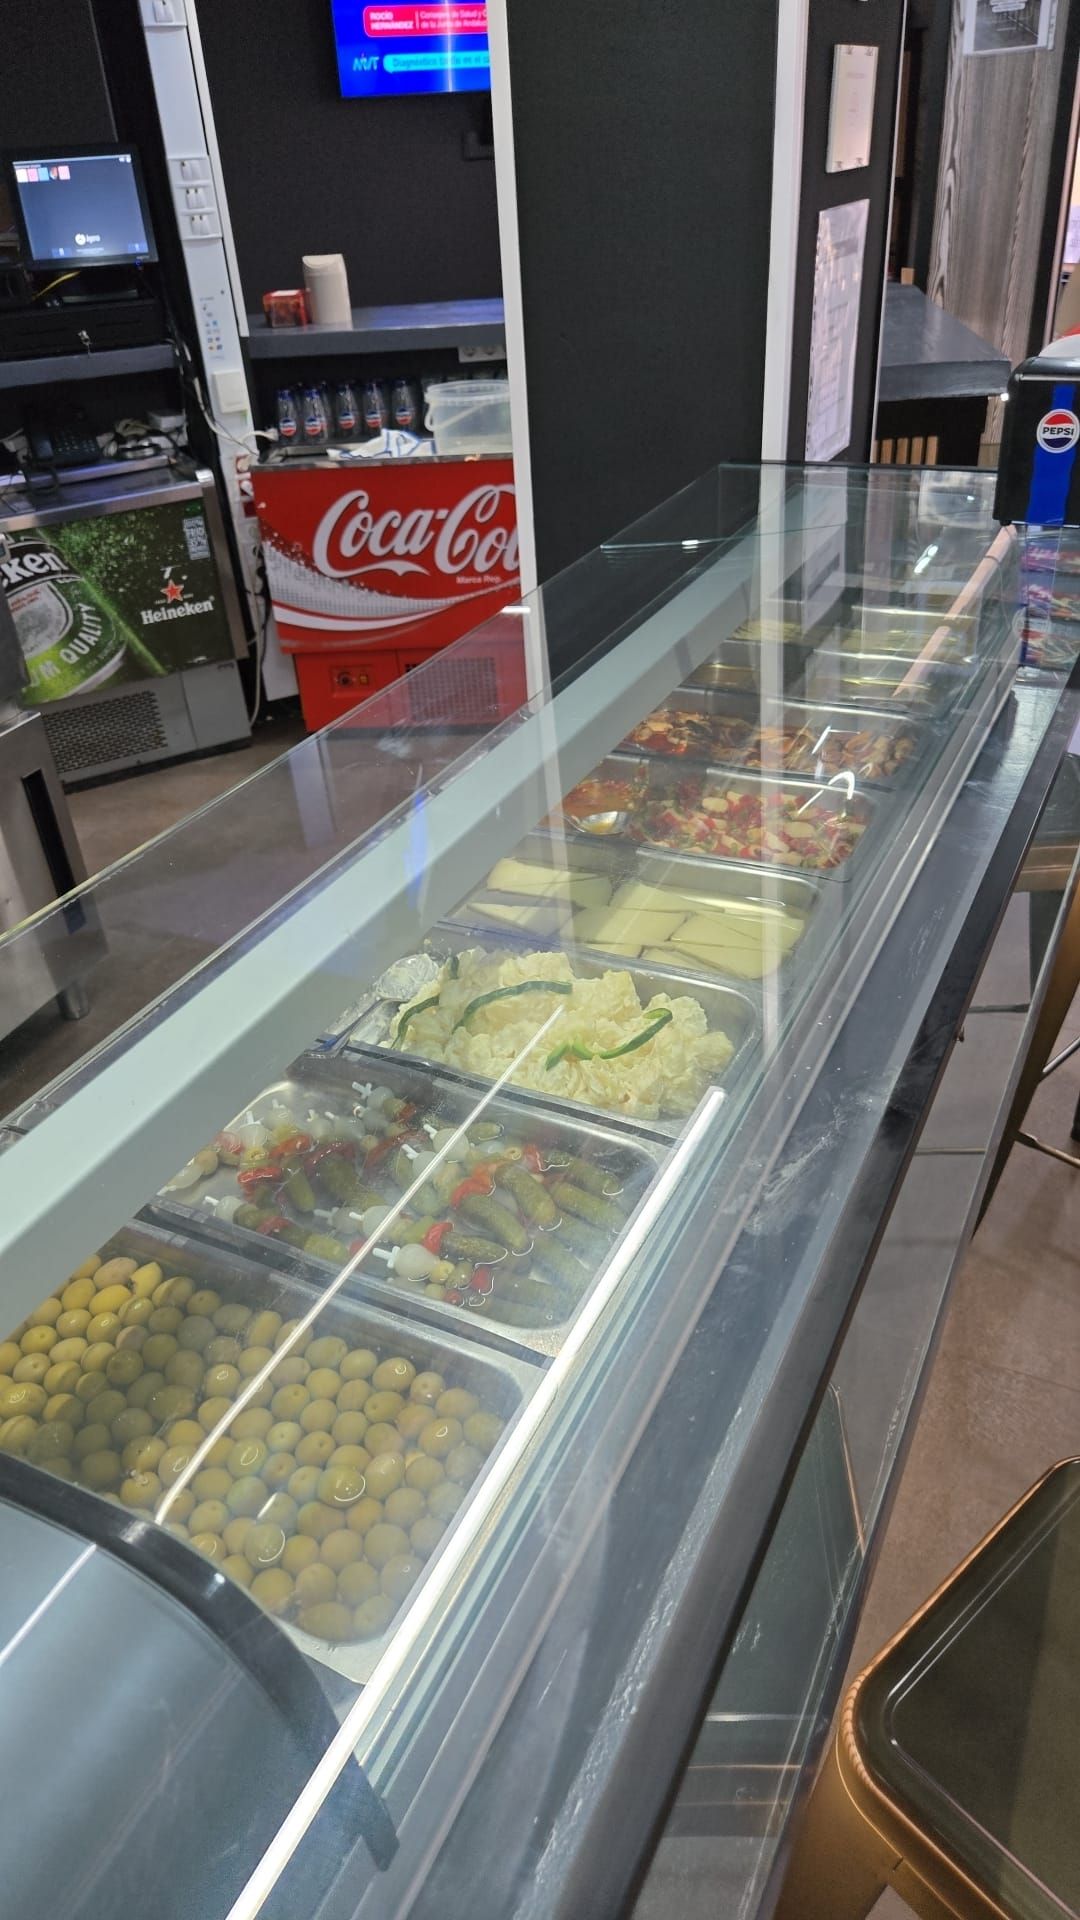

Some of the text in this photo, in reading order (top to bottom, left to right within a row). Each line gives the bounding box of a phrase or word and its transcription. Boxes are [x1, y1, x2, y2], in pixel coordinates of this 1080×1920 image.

[1042, 426, 1075, 436] PEPSI
[141, 600, 214, 625] Heineken
[60, 602, 102, 664] QUALITY
